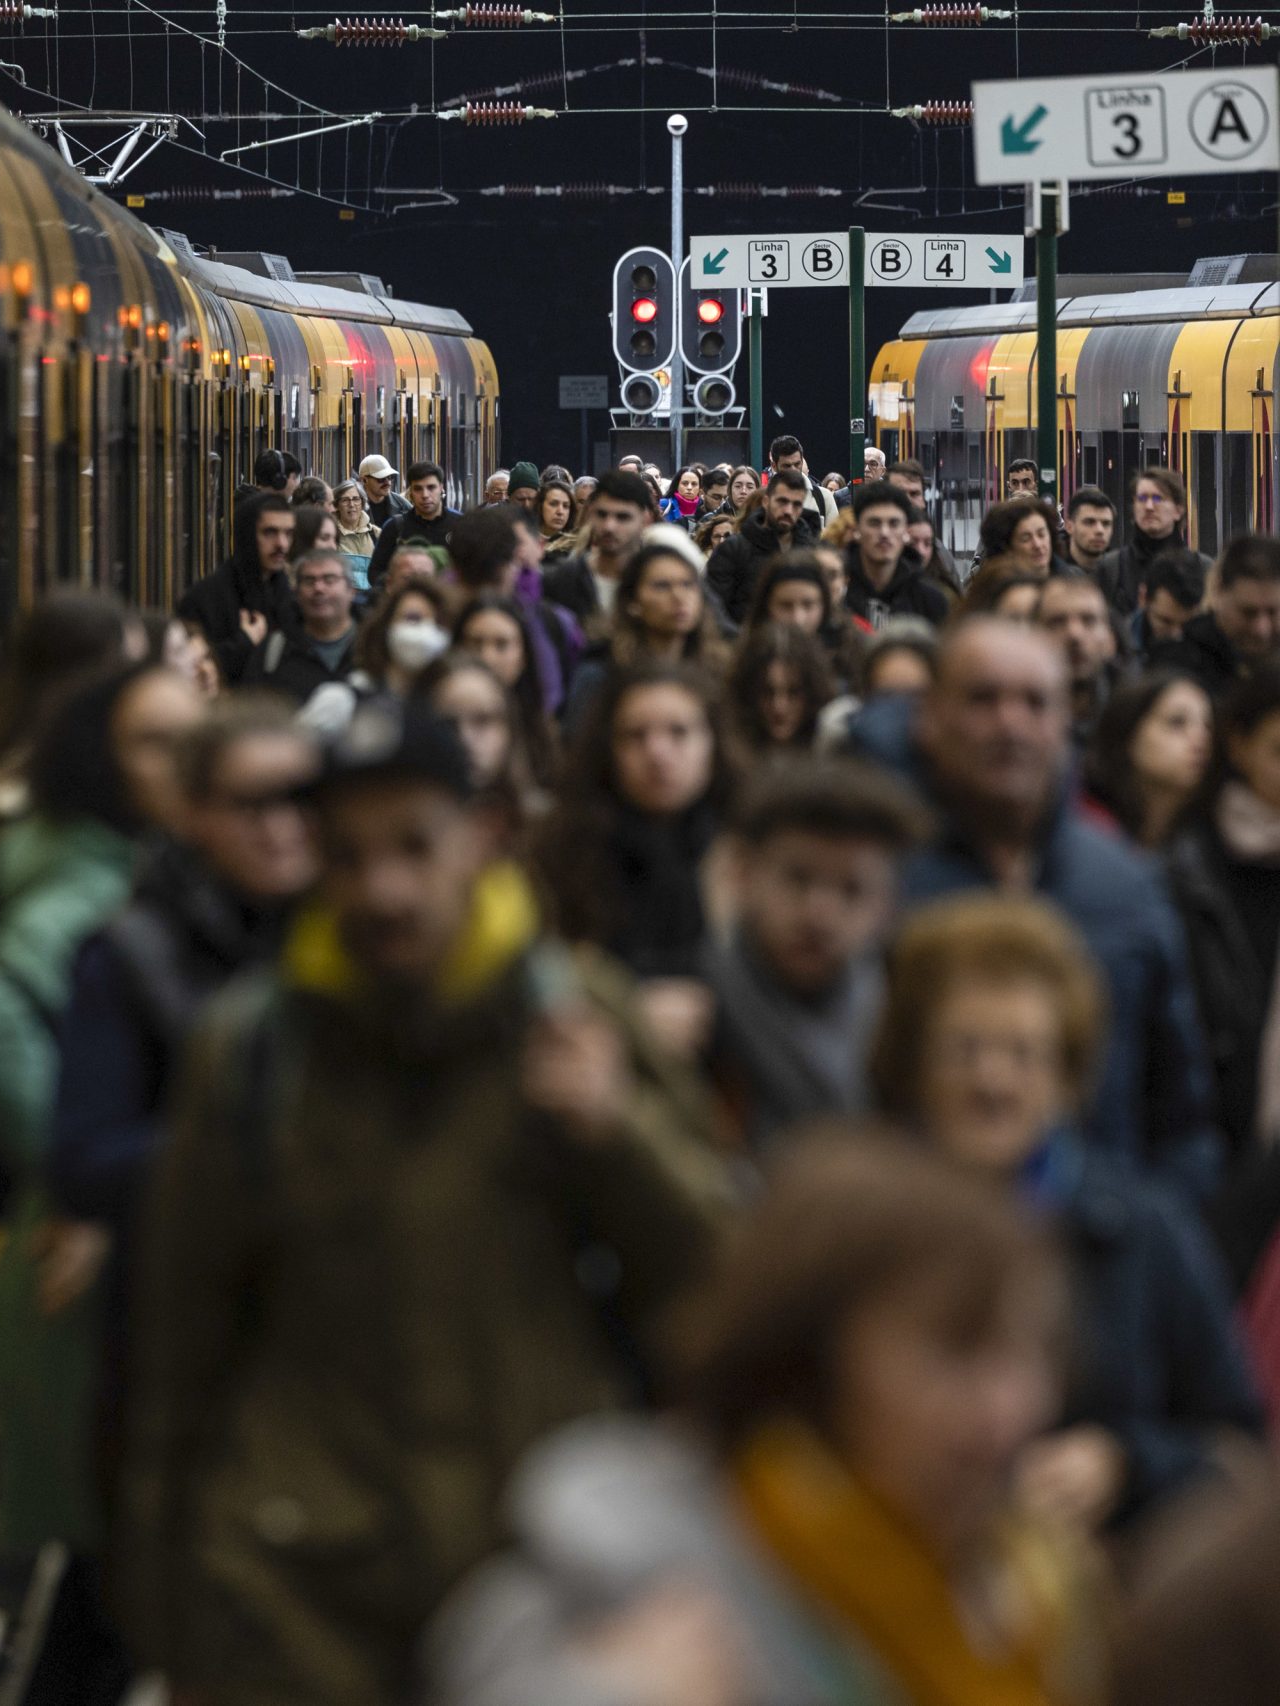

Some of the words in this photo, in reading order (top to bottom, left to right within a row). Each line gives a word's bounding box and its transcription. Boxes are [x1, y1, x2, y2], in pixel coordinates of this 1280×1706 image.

[1097, 92, 1152, 108] Linha
[1209, 99, 1251, 144] A
[1113, 113, 1142, 160] 3
[754, 243, 783, 252] Linha
[931, 242, 959, 251] Linha
[761, 254, 777, 278] 3
[813, 248, 833, 272] B
[881, 249, 901, 272] B
[936, 253, 953, 277] 4
